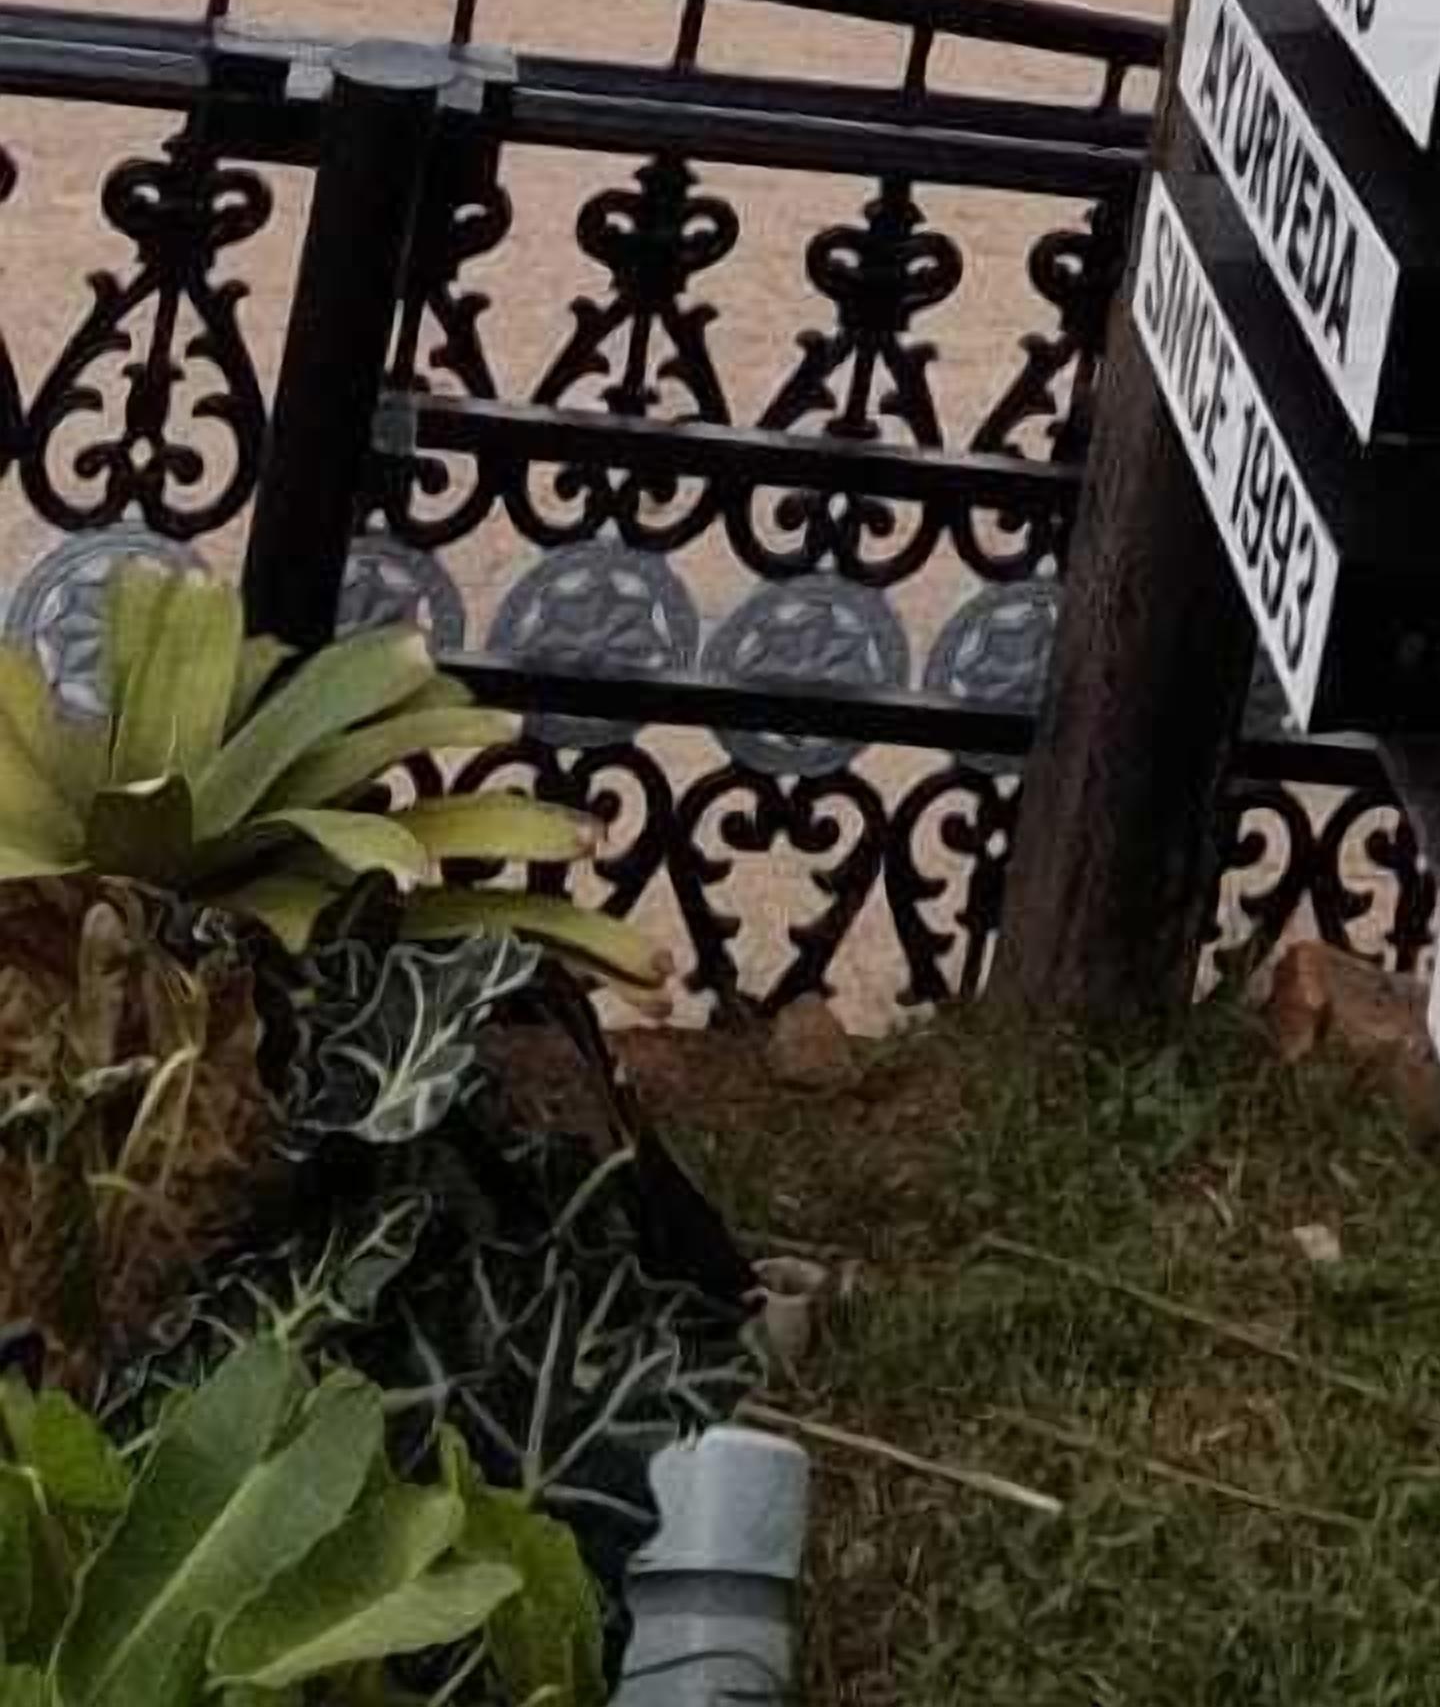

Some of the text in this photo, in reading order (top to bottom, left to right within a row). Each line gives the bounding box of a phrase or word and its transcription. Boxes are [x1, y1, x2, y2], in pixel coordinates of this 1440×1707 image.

[1197, 4, 1359, 368] AYURVEDA
[1144, 208, 1318, 671] SINCE 1993
